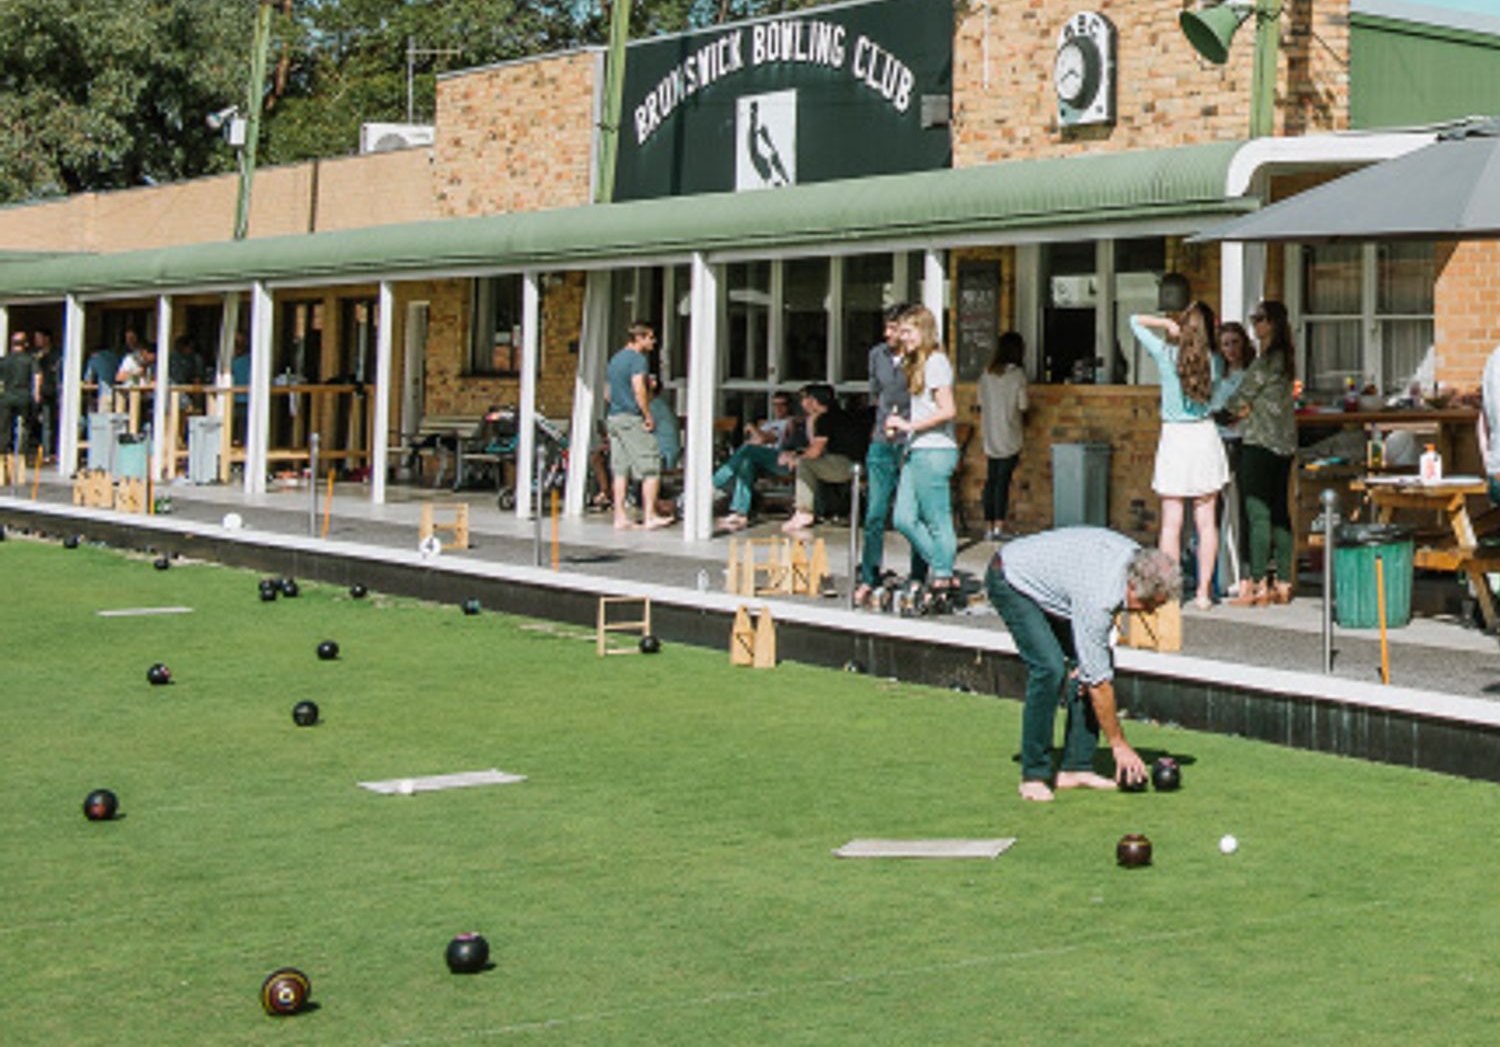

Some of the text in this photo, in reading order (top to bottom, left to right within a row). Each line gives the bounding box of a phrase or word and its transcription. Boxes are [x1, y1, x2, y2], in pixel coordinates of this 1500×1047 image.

[634, 21, 915, 145] BRUNSWICK BOWLING CLUB
